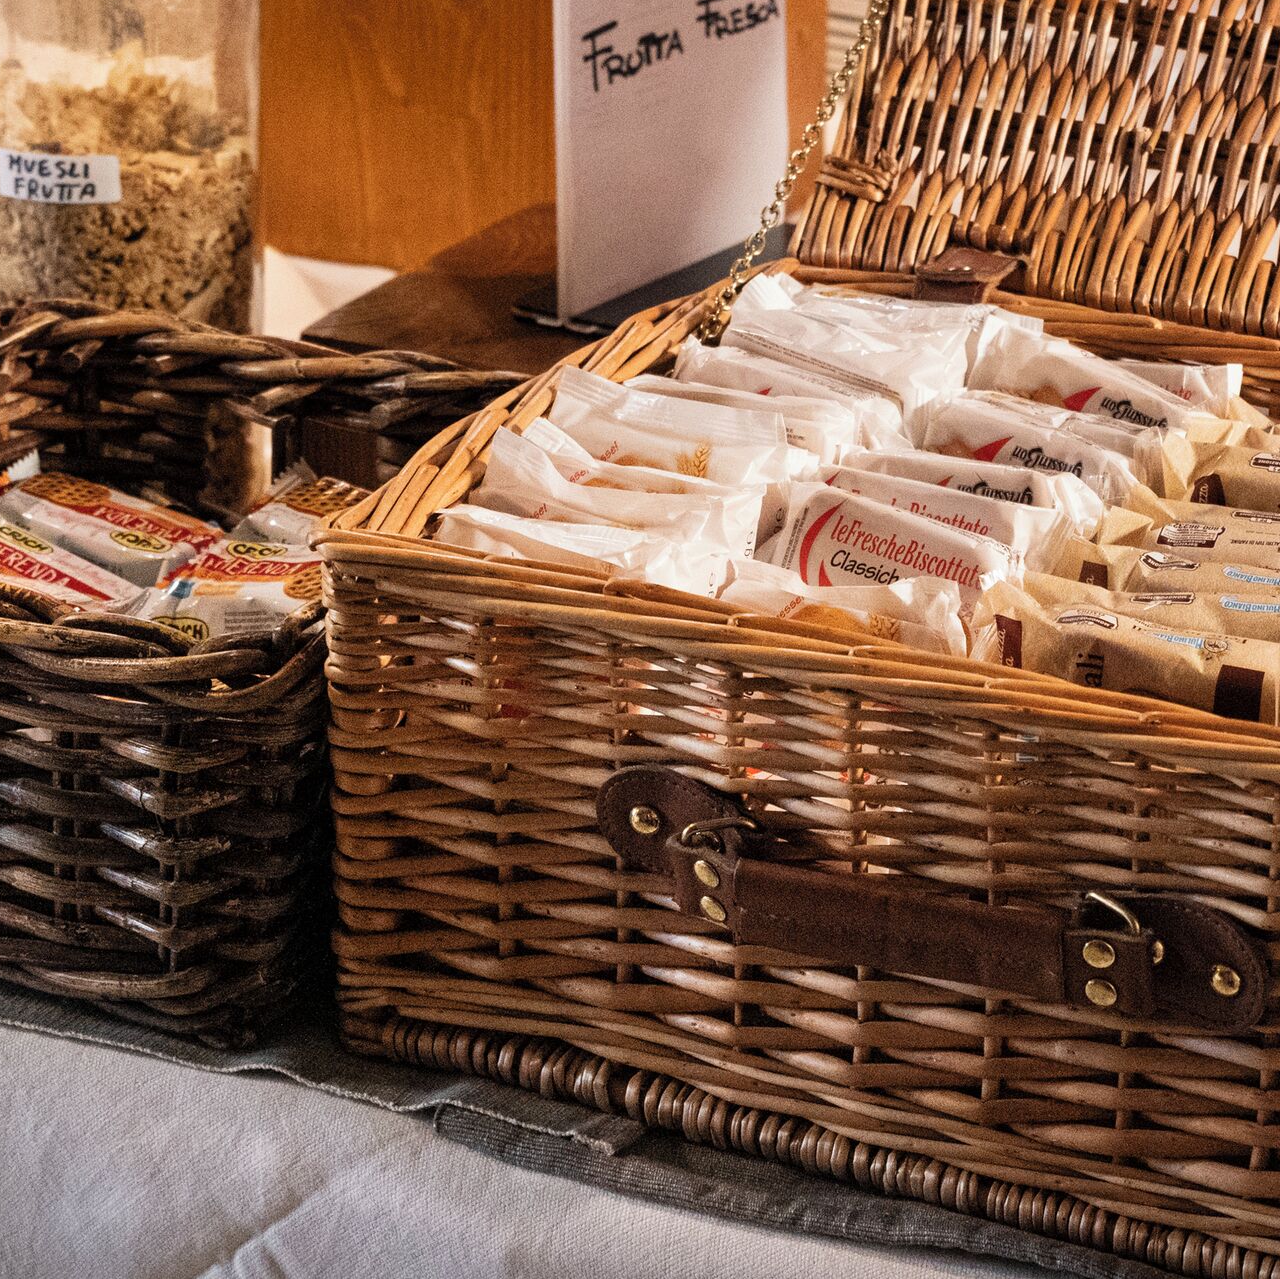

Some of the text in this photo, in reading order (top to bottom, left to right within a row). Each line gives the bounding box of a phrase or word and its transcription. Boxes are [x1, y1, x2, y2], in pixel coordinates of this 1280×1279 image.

[581, 20, 684, 92] FRUTTA
[8, 153, 90, 178] MUESLI
[13, 177, 96, 201] FRUTTA
[830, 549, 900, 586] Classich
